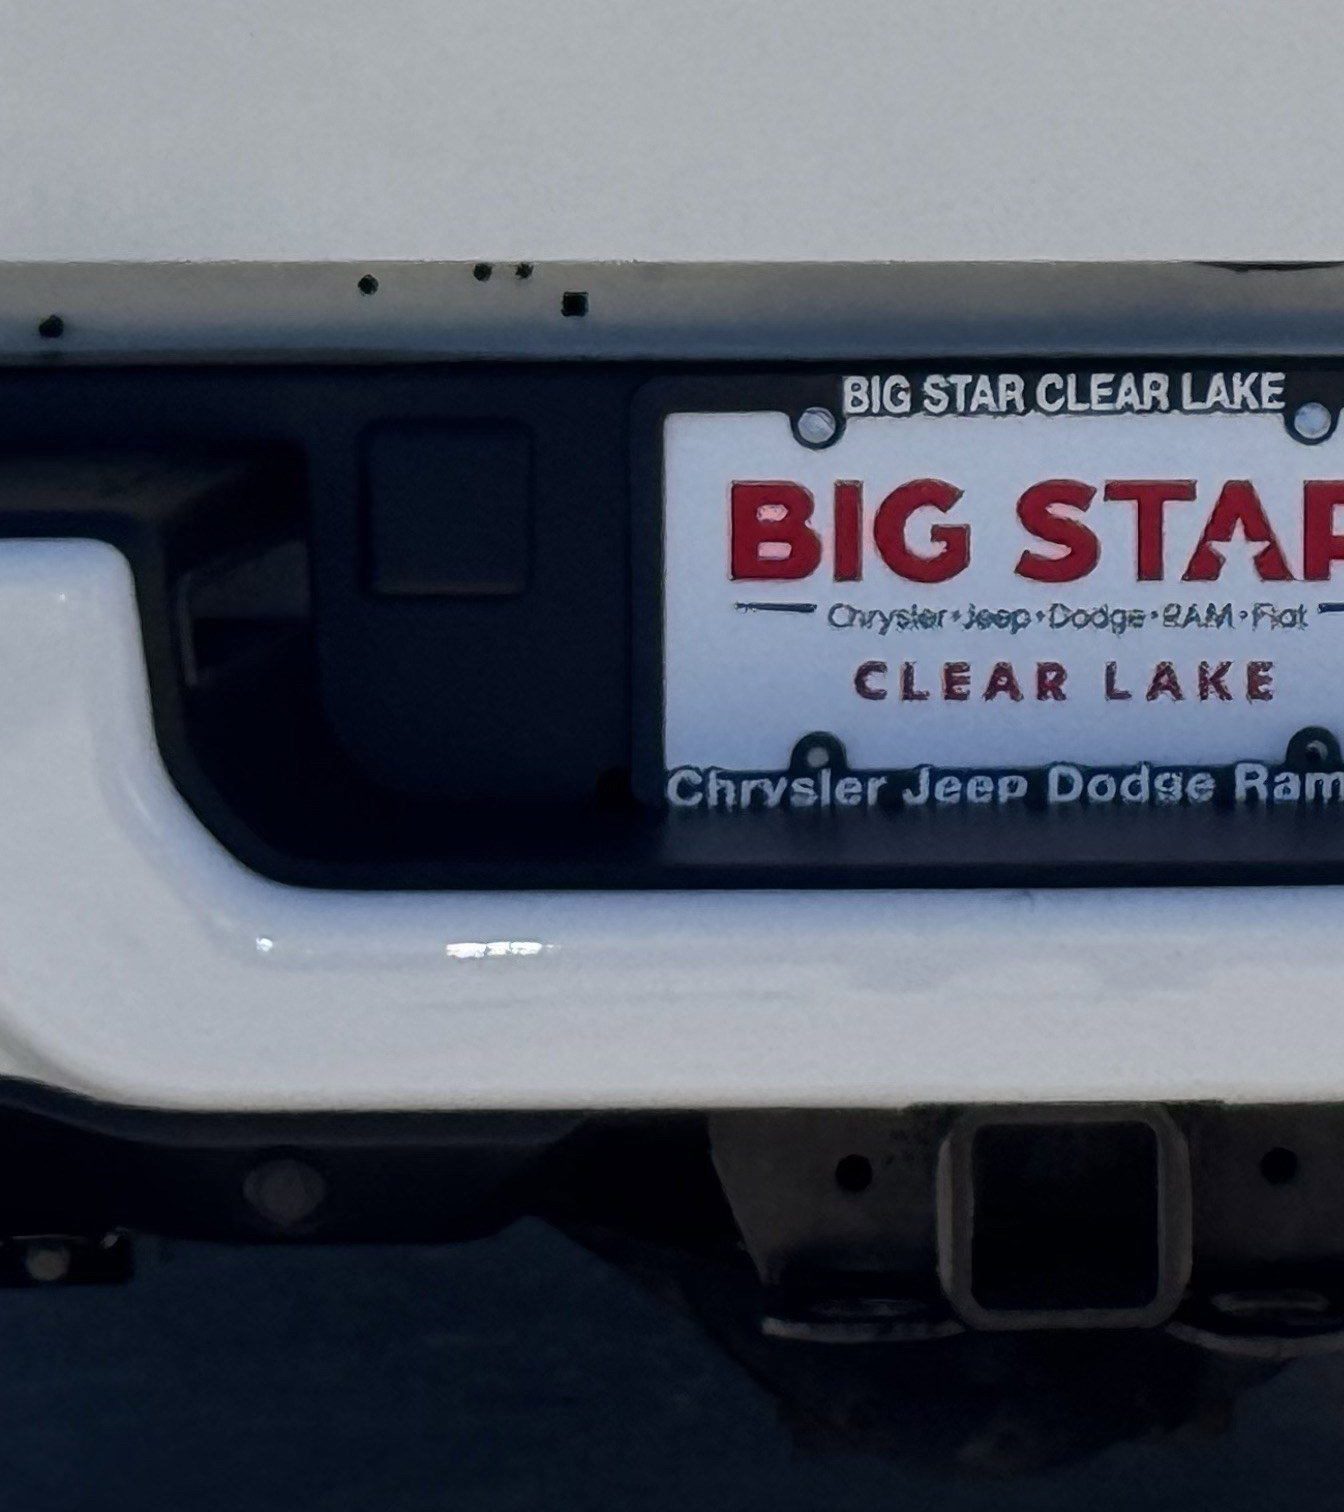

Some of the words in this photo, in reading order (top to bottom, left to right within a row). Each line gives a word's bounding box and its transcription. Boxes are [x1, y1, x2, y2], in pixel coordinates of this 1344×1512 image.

[843, 375, 911, 414] BIG
[923, 374, 1024, 413] STAR
[1036, 373, 1169, 412] CLEAR
[1182, 372, 1286, 410] LAKE
[730, 479, 970, 581] BIG
[853, 660, 1068, 701] CLEAR
[1104, 660, 1275, 701] LAKE
[666, 769, 888, 808] Chrysler
[902, 767, 1028, 805] Jeep
[1048, 765, 1216, 804] Dodge
